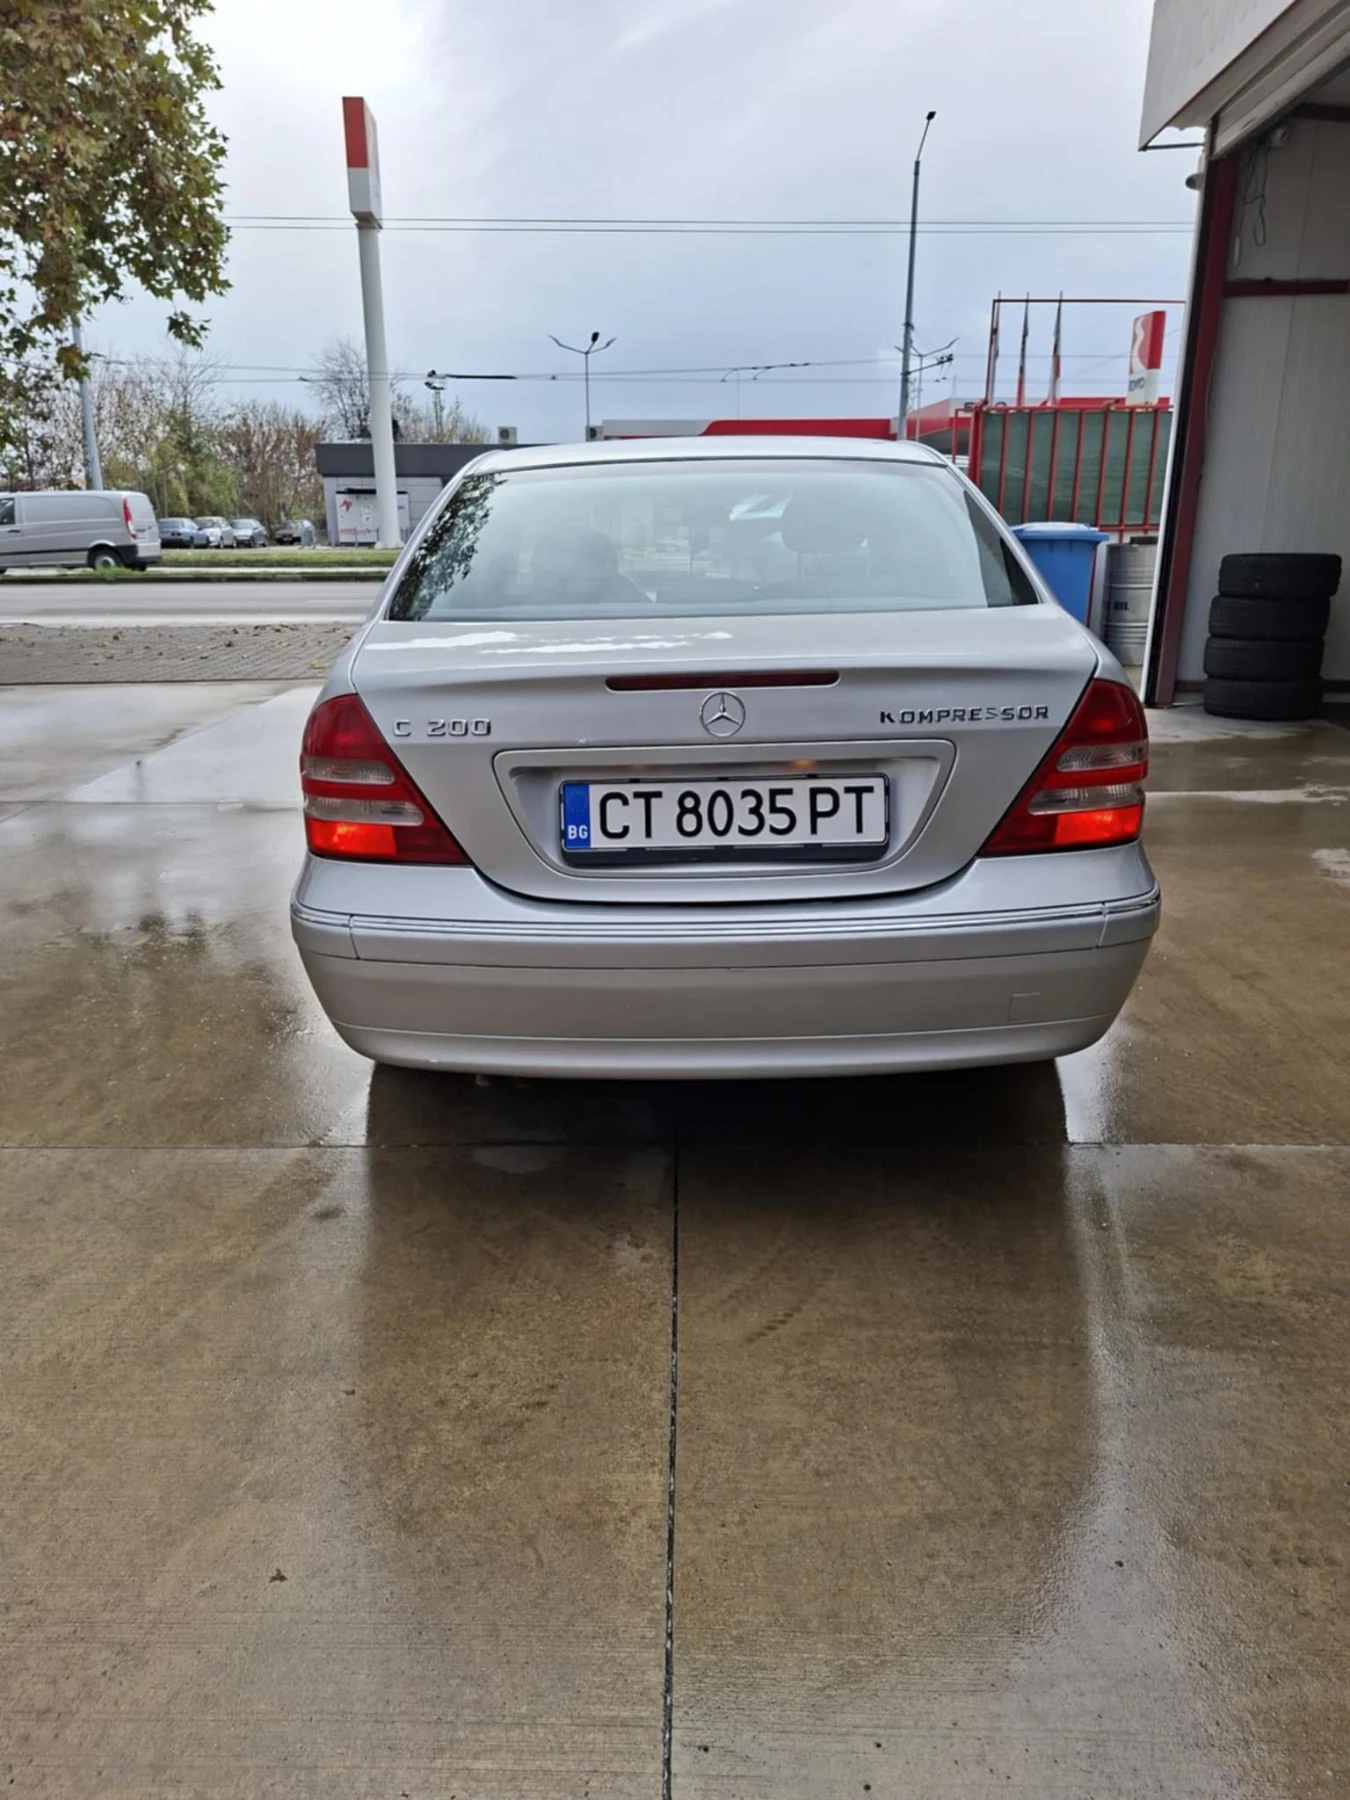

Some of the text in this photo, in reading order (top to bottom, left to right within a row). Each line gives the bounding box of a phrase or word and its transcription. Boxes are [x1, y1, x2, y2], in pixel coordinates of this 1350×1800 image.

[879, 705, 1049, 724] KOMPRESSOR
[393, 718, 491, 737] C 200
[599, 785, 875, 839] CT 8035 PT
[567, 825, 588, 839] BG
